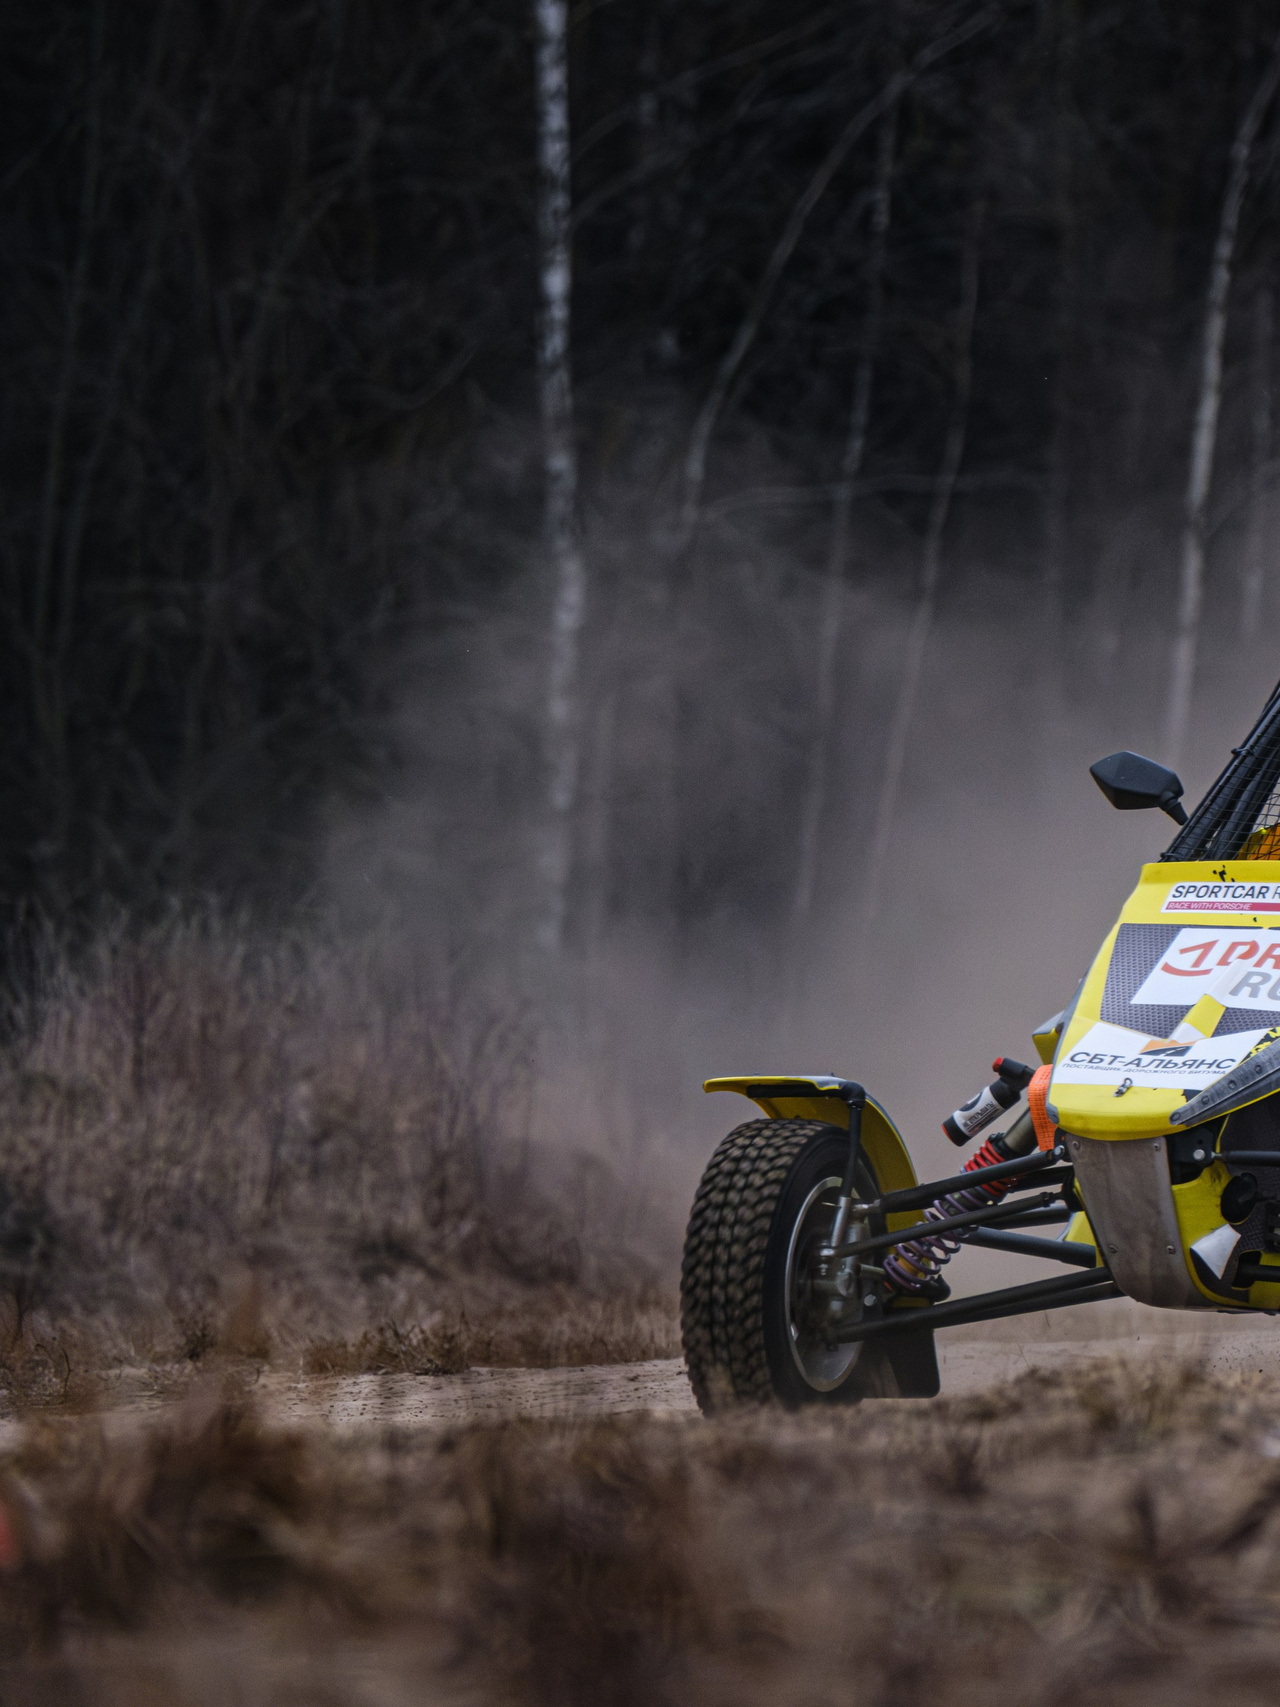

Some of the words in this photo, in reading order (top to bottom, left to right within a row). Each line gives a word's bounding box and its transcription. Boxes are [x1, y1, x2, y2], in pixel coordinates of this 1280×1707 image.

[1172, 885, 1270, 899] SPORTCAR
[1062, 1063, 1122, 1072] ПОСТАВЩИК
[1069, 1051, 1237, 1070] СБТ-АЛЬЯНС
